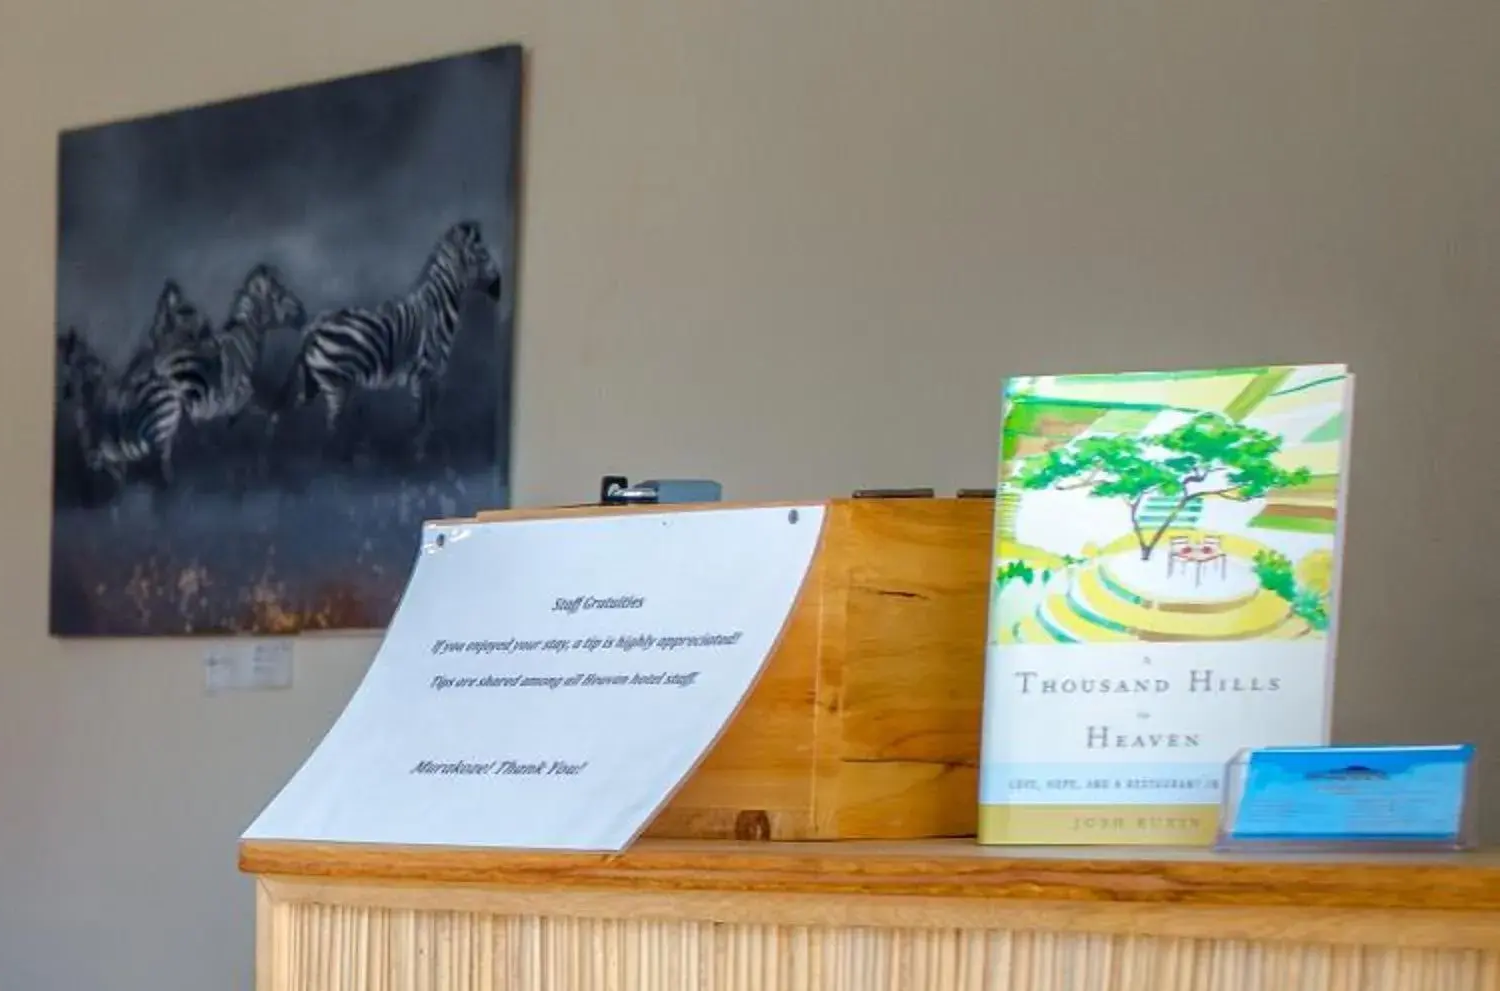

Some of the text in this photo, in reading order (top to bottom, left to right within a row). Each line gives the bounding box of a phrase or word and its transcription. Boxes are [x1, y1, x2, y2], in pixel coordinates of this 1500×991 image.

[551, 595, 645, 614] Staff Gratuities
[440, 641, 467, 655] you
[465, 637, 516, 655] enjoyed
[507, 640, 543, 655] your
[581, 637, 602, 652] tip
[601, 637, 614, 649] is
[614, 633, 657, 652] highly
[430, 675, 456, 691] Tips
[454, 677, 479, 688] are
[475, 674, 523, 688] shared
[519, 677, 564, 690] among
[562, 673, 586, 687] all
[628, 672, 668, 685] hotel
[1014, 669, 1282, 695] THOUSAND HILLS
[1085, 725, 1201, 750] HEAVEN
[494, 760, 548, 775] Thank
[546, 760, 589, 775] You!
